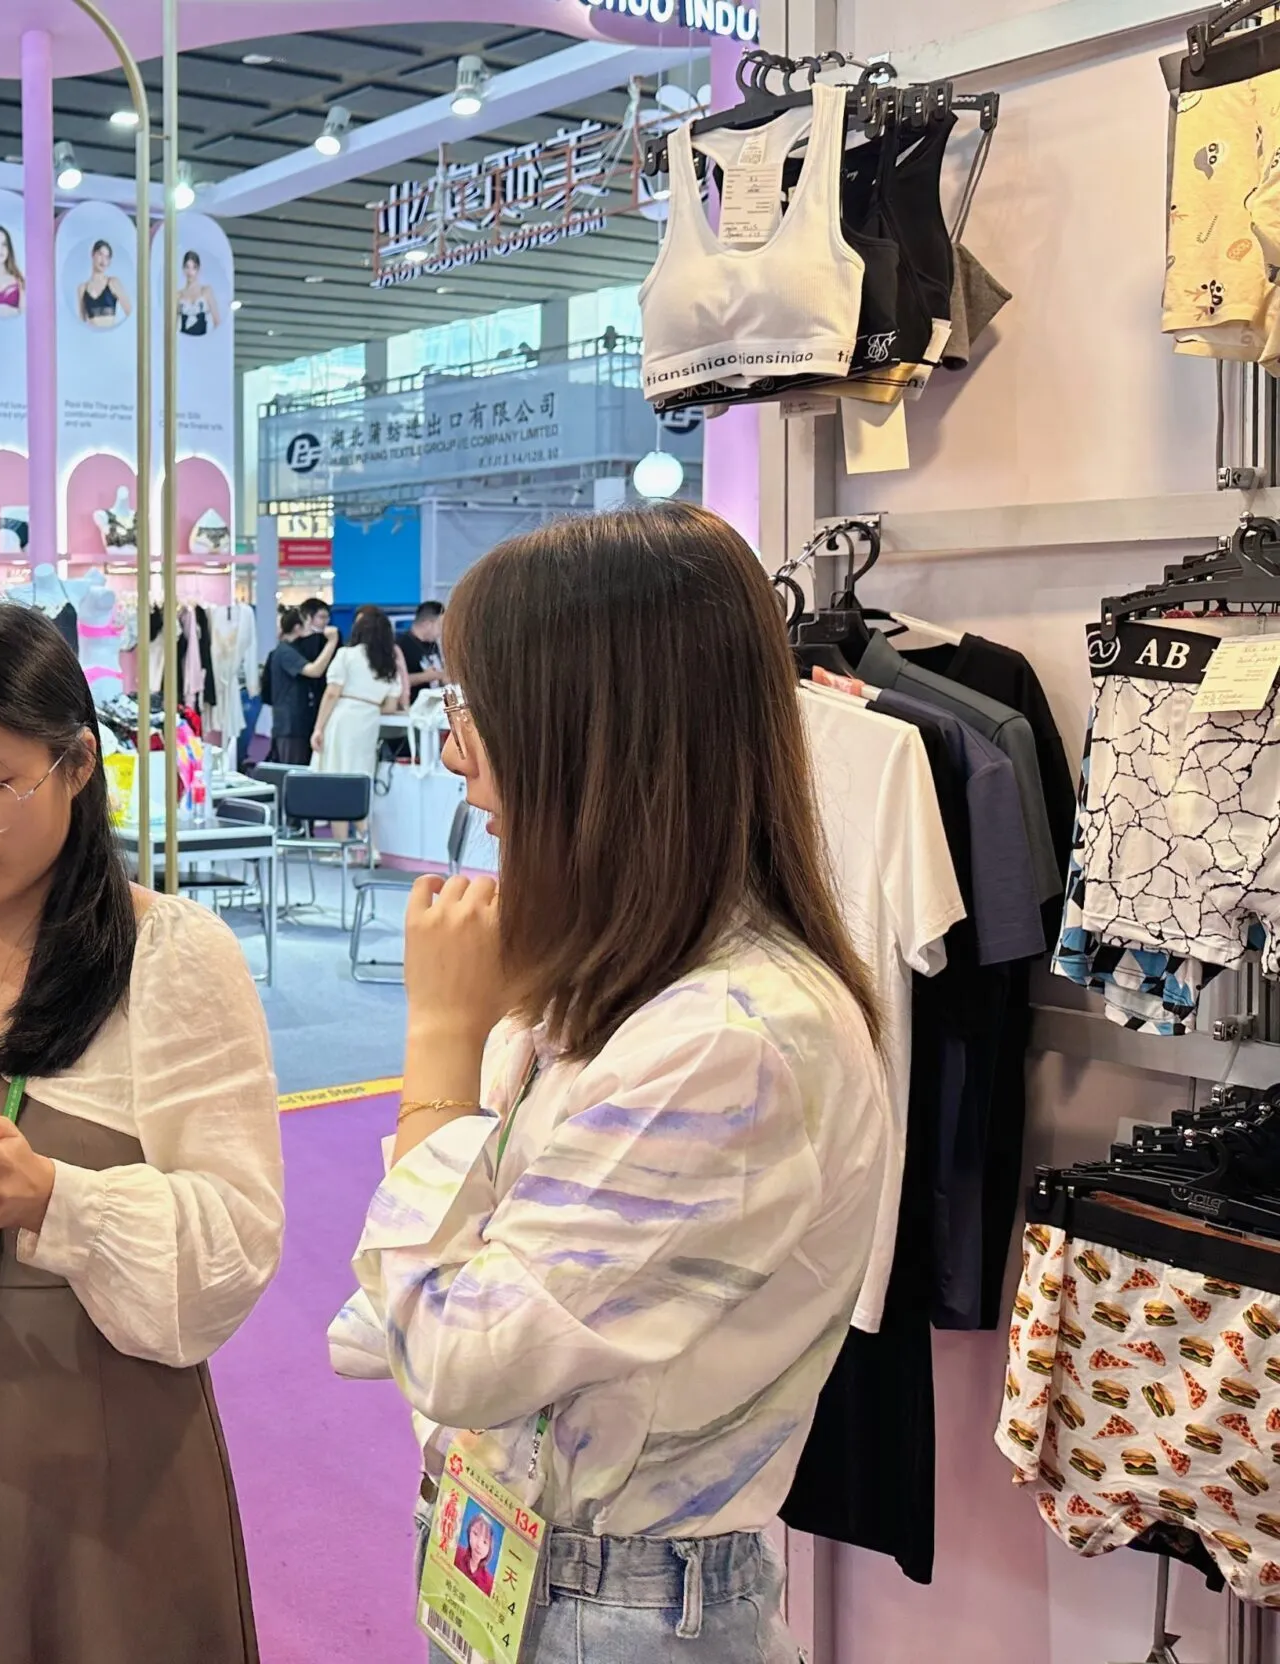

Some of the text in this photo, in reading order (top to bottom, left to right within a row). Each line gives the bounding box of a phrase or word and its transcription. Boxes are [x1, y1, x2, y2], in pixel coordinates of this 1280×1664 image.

[683, 0, 760, 41] INDU
[646, 354, 738, 386] tiansiniao
[423, 439, 456, 455] GROUP
[470, 431, 519, 449] COMPANY
[520, 424, 559, 441] LIMITED
[514, 1507, 541, 1540] 134
[507, 1600, 517, 1617] 4
[502, 1633, 511, 1648] 4
